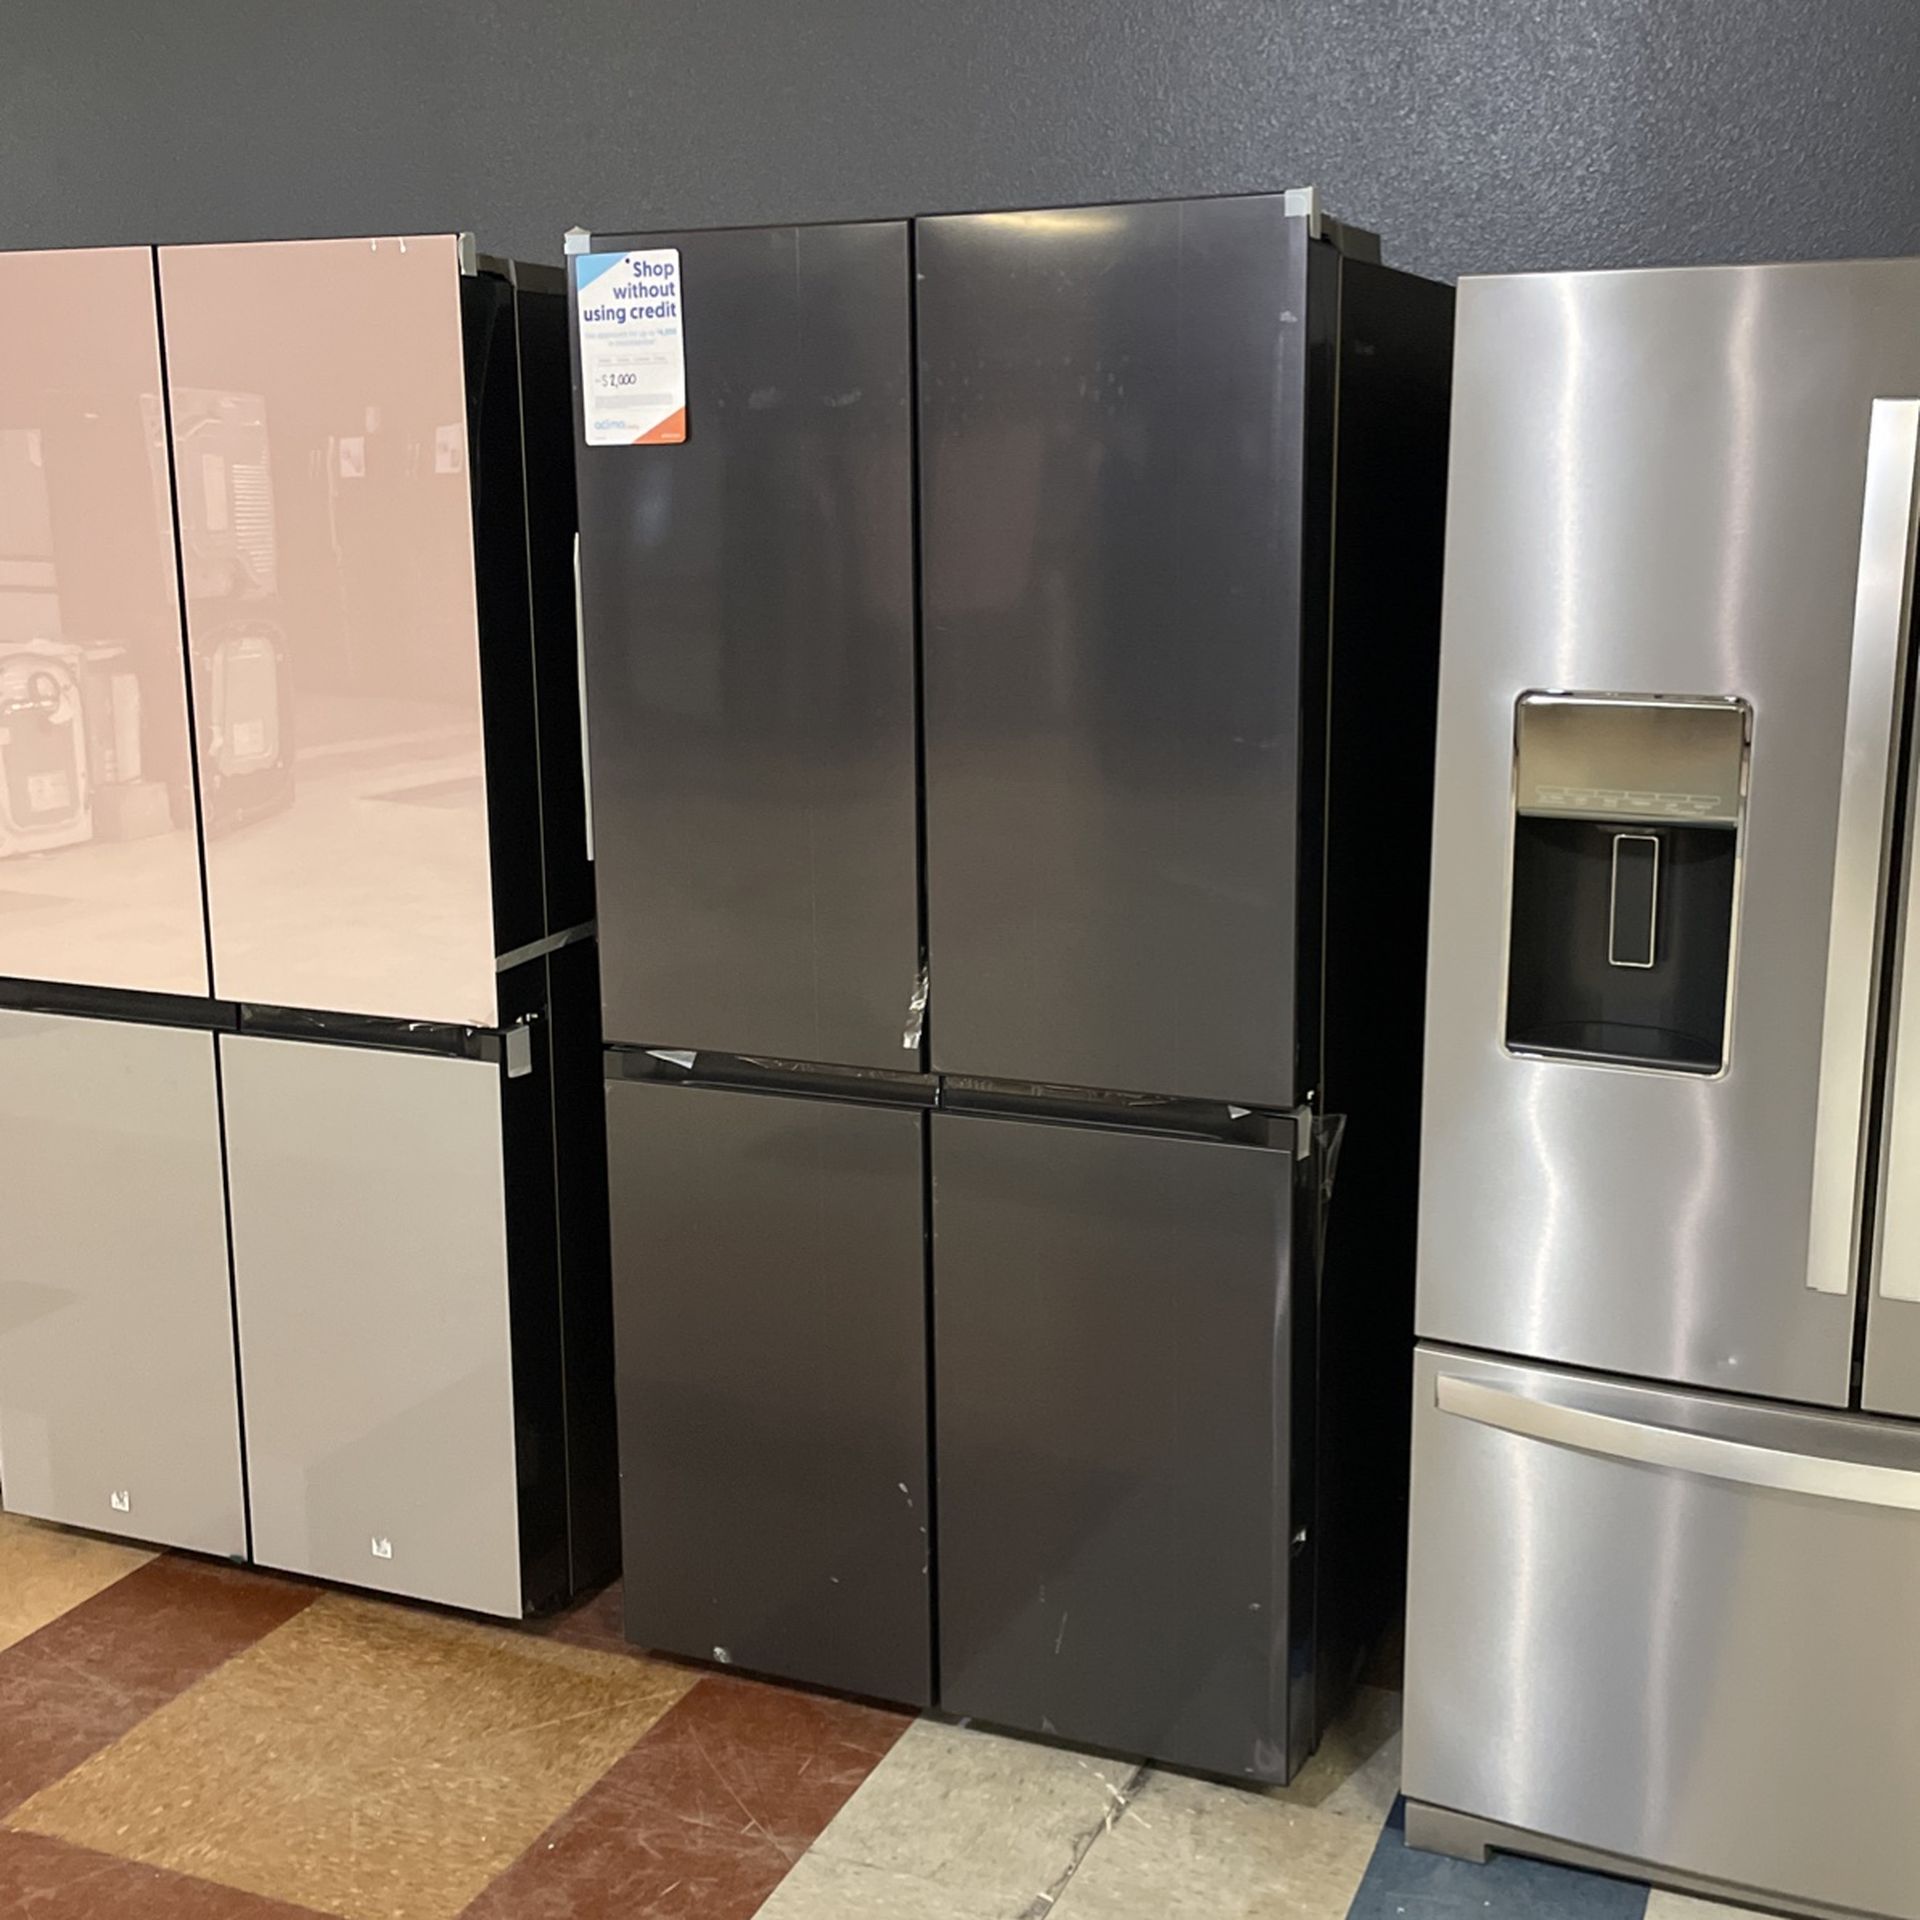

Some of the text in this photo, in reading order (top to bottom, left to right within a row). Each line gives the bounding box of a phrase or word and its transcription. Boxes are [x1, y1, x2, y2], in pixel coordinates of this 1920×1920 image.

[633, 261, 674, 279] Shop
[613, 282, 676, 299] without
[583, 301, 677, 324] using credit
